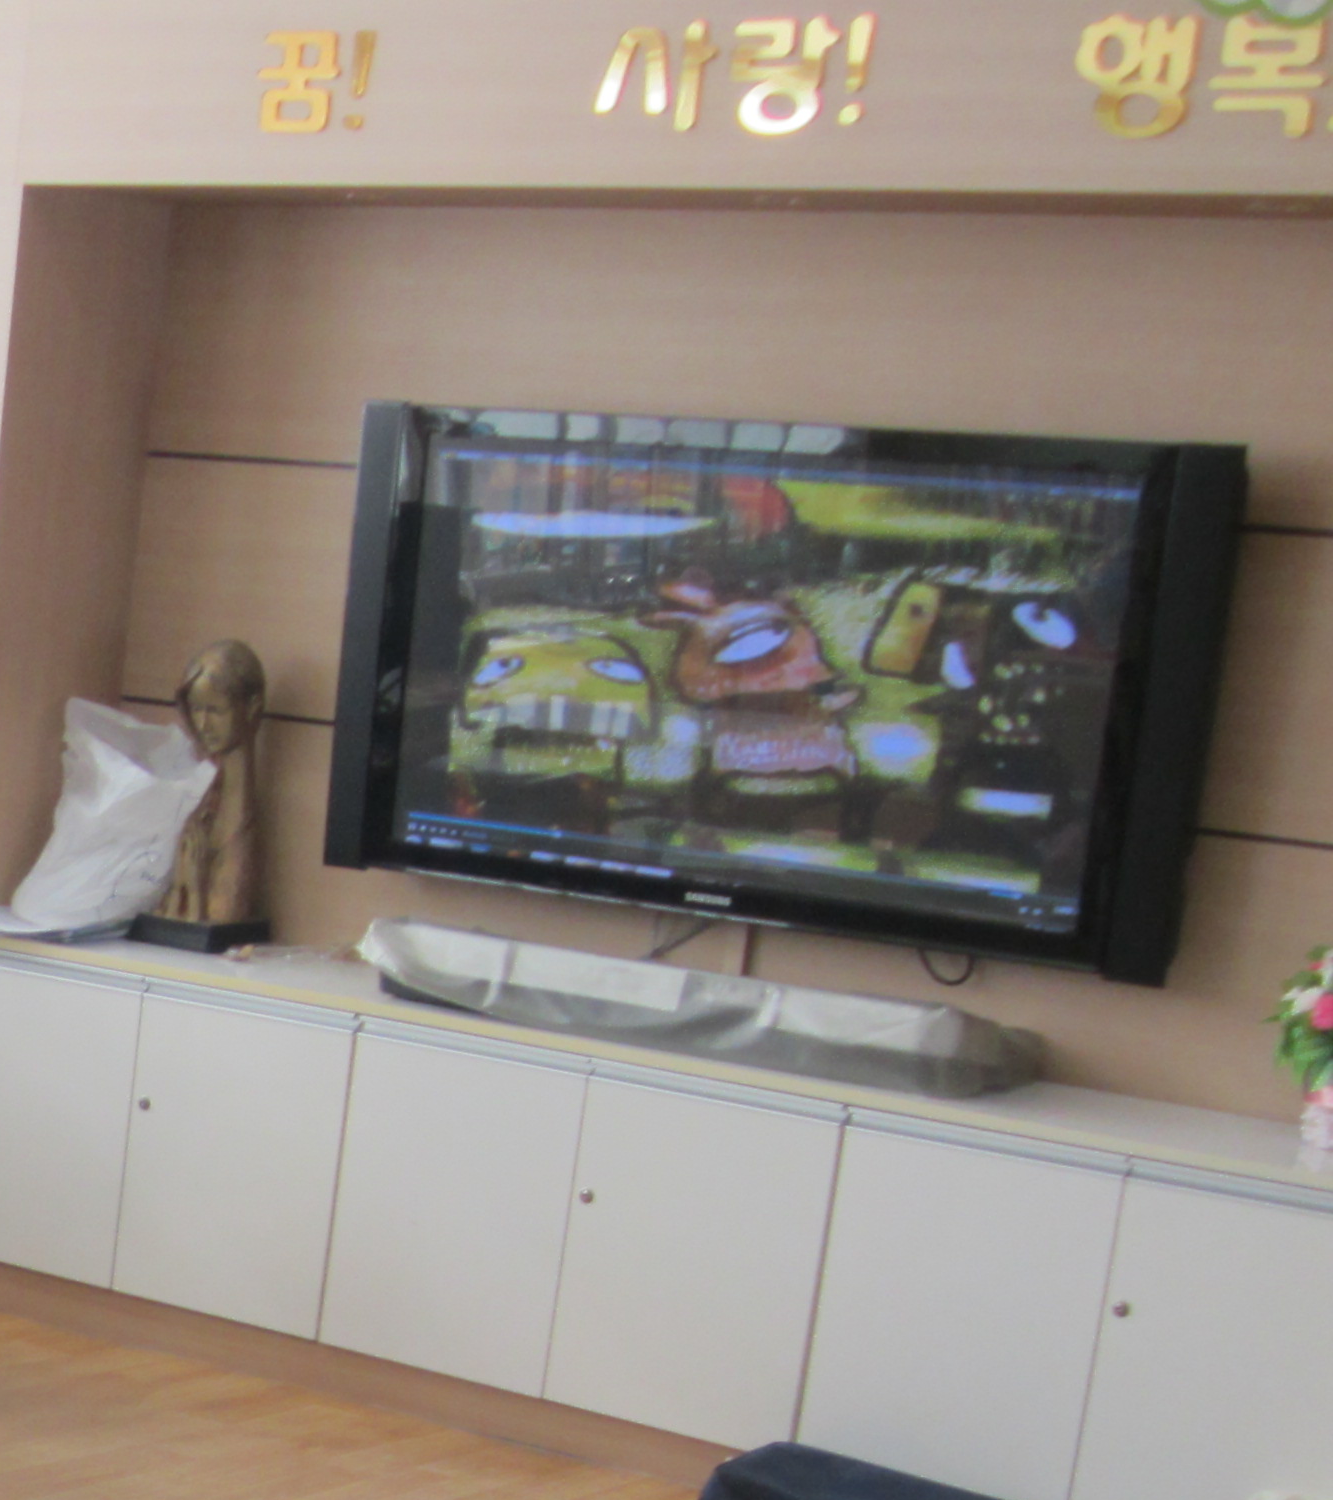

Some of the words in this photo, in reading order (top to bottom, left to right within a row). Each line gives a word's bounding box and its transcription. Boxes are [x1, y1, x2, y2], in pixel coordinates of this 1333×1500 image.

[257, 28, 378, 134] 꿈!
[592, 11, 877, 137] 사랑!
[1074, 13, 1333, 139] 행복
